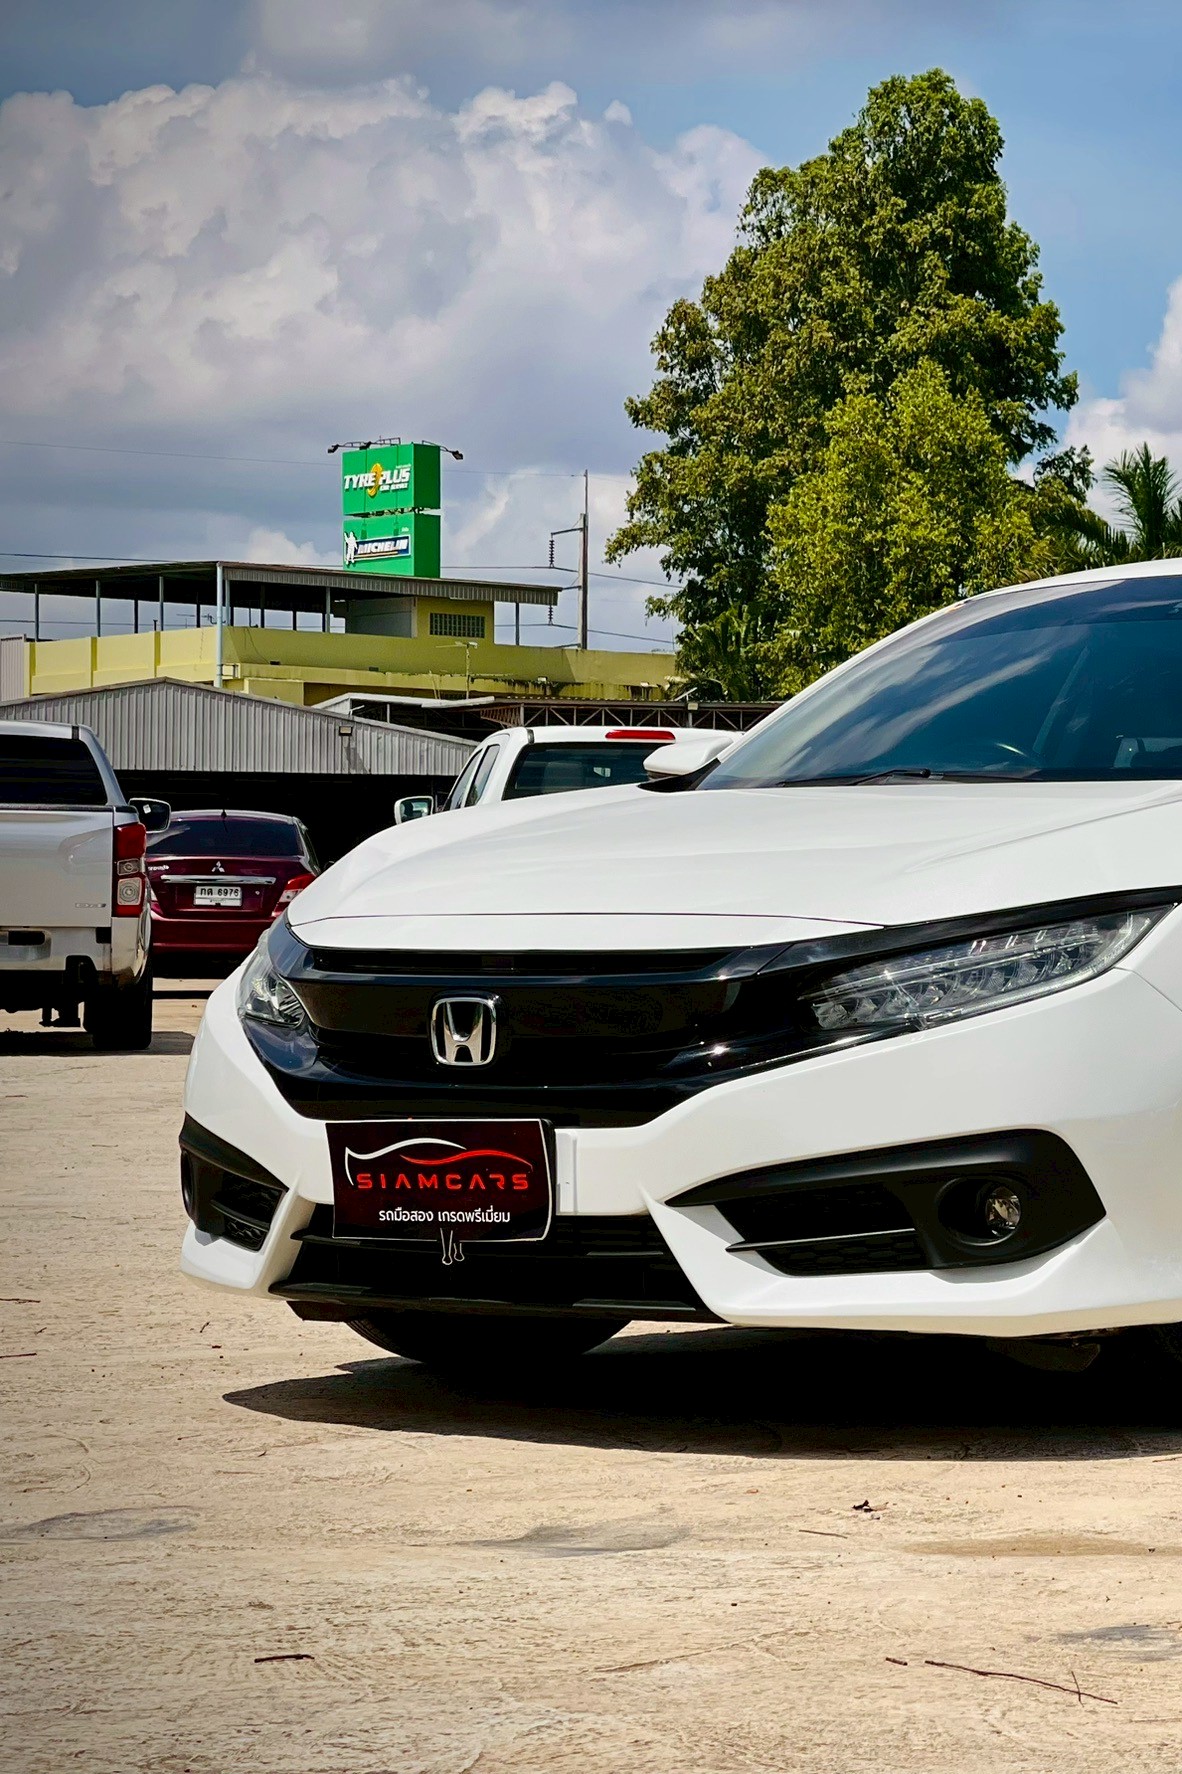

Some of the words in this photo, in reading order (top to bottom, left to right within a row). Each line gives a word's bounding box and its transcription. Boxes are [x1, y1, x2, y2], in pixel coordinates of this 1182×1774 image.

[344, 472, 376, 490] TYRE
[379, 467, 411, 485] PLUS
[217, 888, 239, 897] 6976
[356, 1173, 529, 1190] SIAMCARS
[378, 1206, 434, 1222] รถมือสอง
